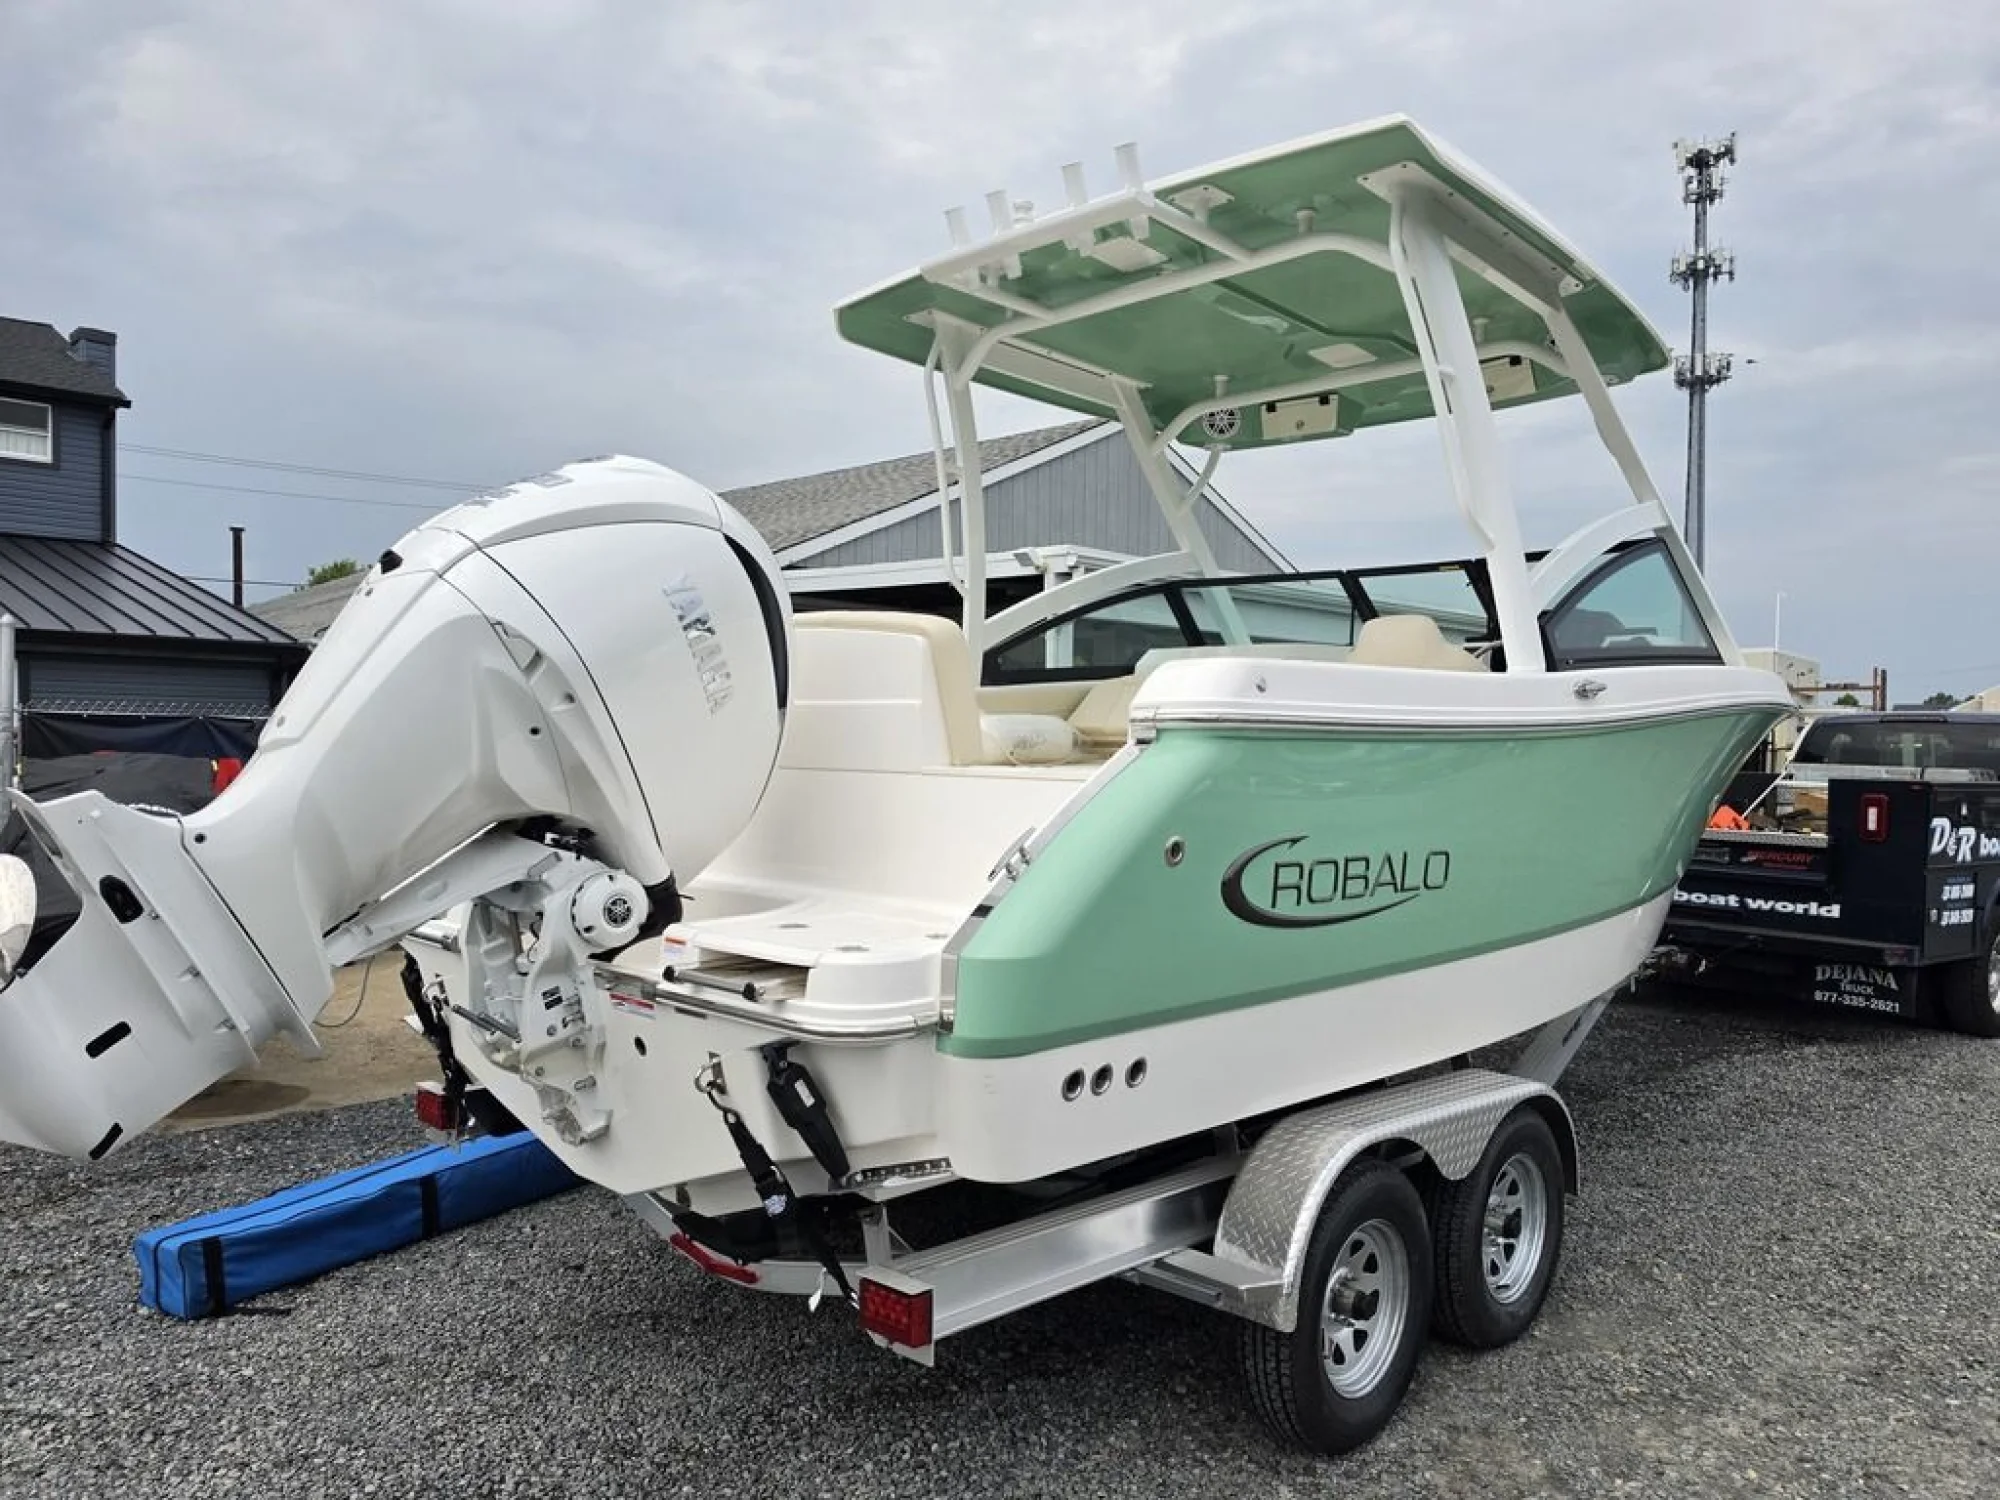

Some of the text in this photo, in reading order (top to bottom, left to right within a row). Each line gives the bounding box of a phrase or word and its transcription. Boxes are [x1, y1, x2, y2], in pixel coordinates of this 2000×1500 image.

[662, 572, 735, 718] YAMAHA
[1930, 817, 2000, 862] D&R bo
[1271, 850, 1451, 909] ROBALO
[1673, 889, 1841, 919] boat world
[1815, 965, 1899, 990] DEJANA
